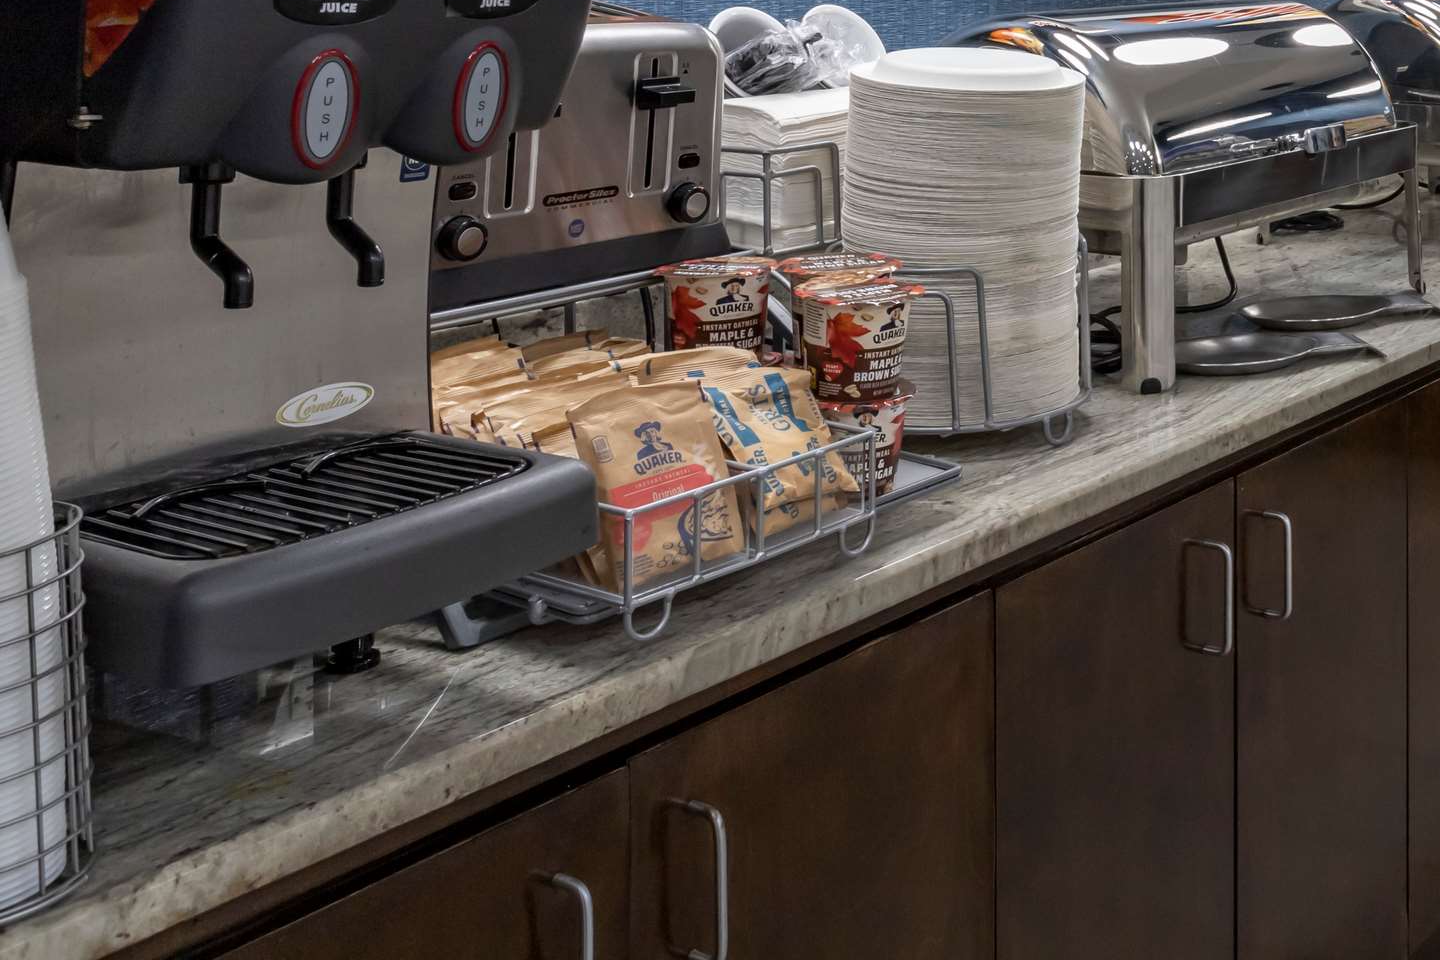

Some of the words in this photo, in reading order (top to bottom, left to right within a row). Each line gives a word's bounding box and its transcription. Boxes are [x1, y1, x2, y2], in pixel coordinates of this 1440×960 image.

[319, 2, 357, 14] JUICE
[475, 66, 490, 127] PUSH
[319, 77, 335, 142] PUSH
[709, 303, 754, 317] QUAKER
[702, 323, 732, 331] INSTANT
[709, 330, 746, 342] MAPLE
[747, 327, 754, 338] &
[853, 369, 890, 382] BROWN
[634, 451, 683, 475] QUAKER
